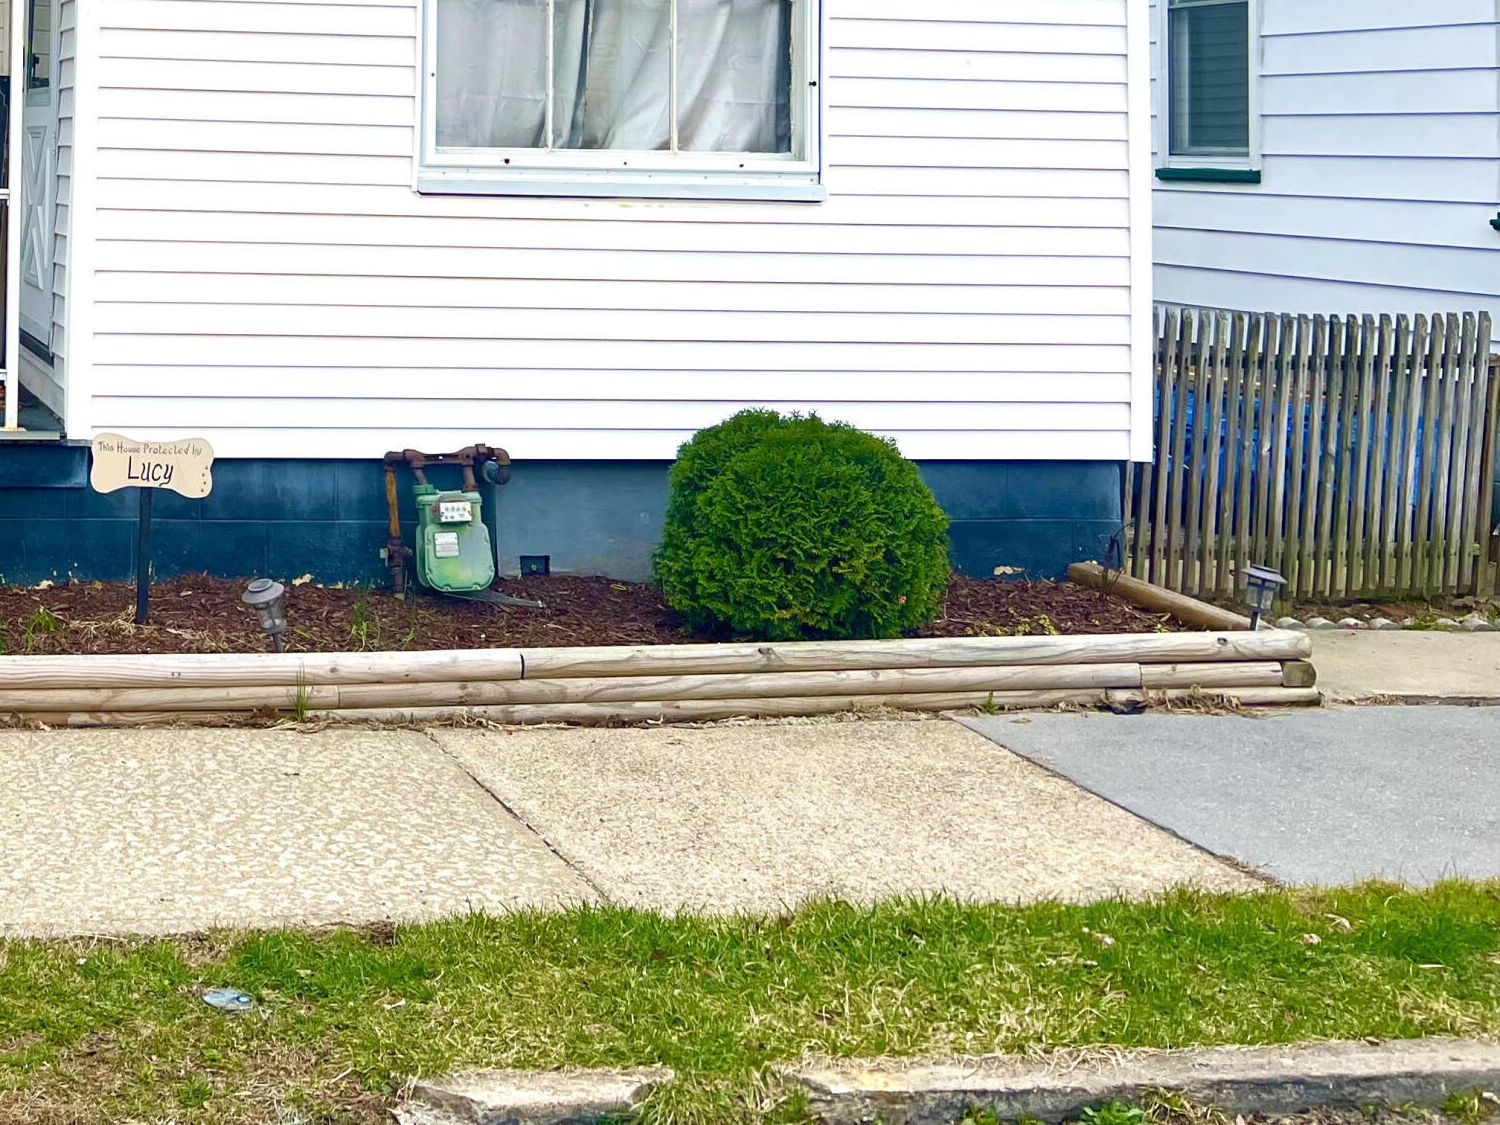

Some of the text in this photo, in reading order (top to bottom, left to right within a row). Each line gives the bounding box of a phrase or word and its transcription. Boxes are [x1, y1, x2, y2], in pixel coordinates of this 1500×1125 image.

[97, 441, 202, 457] This House Protected by
